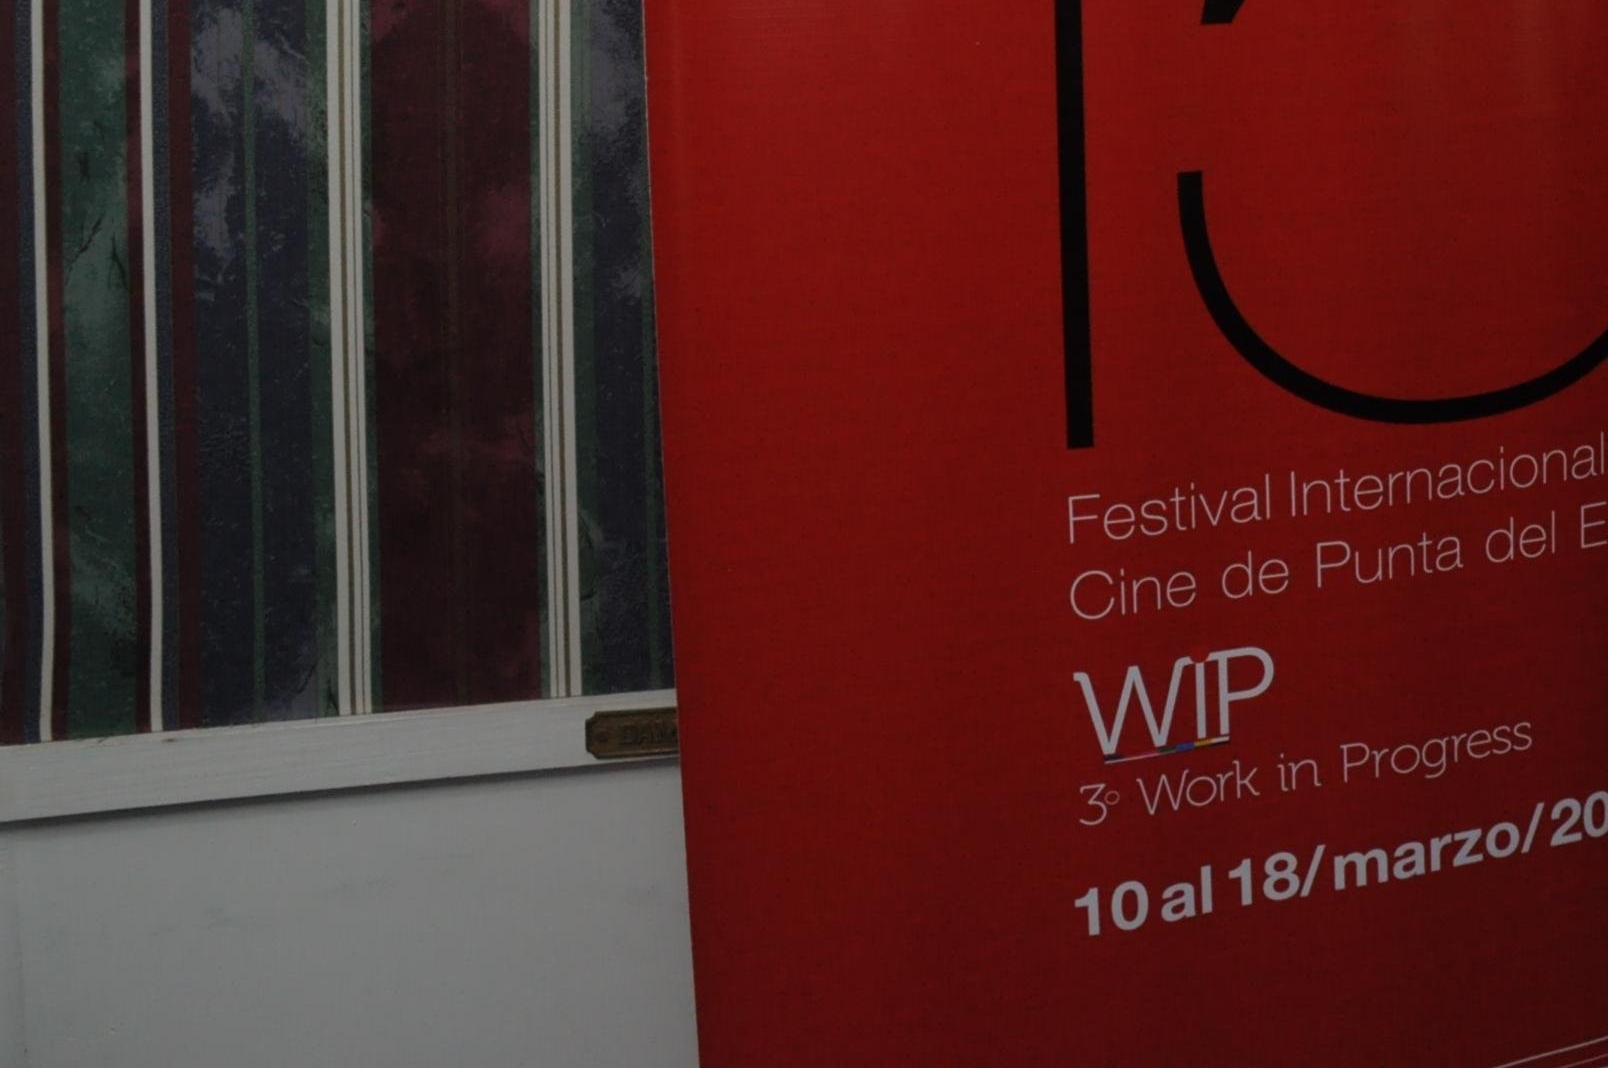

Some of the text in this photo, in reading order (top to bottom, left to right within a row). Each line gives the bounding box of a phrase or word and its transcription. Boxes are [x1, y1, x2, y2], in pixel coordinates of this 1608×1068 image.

[1067, 473, 1271, 544] Festival
[1290, 431, 1605, 517] Internacional
[1069, 568, 1197, 620] Cine
[1221, 550, 1289, 599] de
[1316, 534, 1464, 589] Punta
[1485, 511, 1556, 563] del
[1072, 646, 1275, 755] WIP
[1135, 759, 1261, 816] Work
[1277, 752, 1322, 792] in
[1339, 721, 1533, 780] Progress
[1074, 880, 1149, 936] 10
[1160, 864, 1213, 922] al
